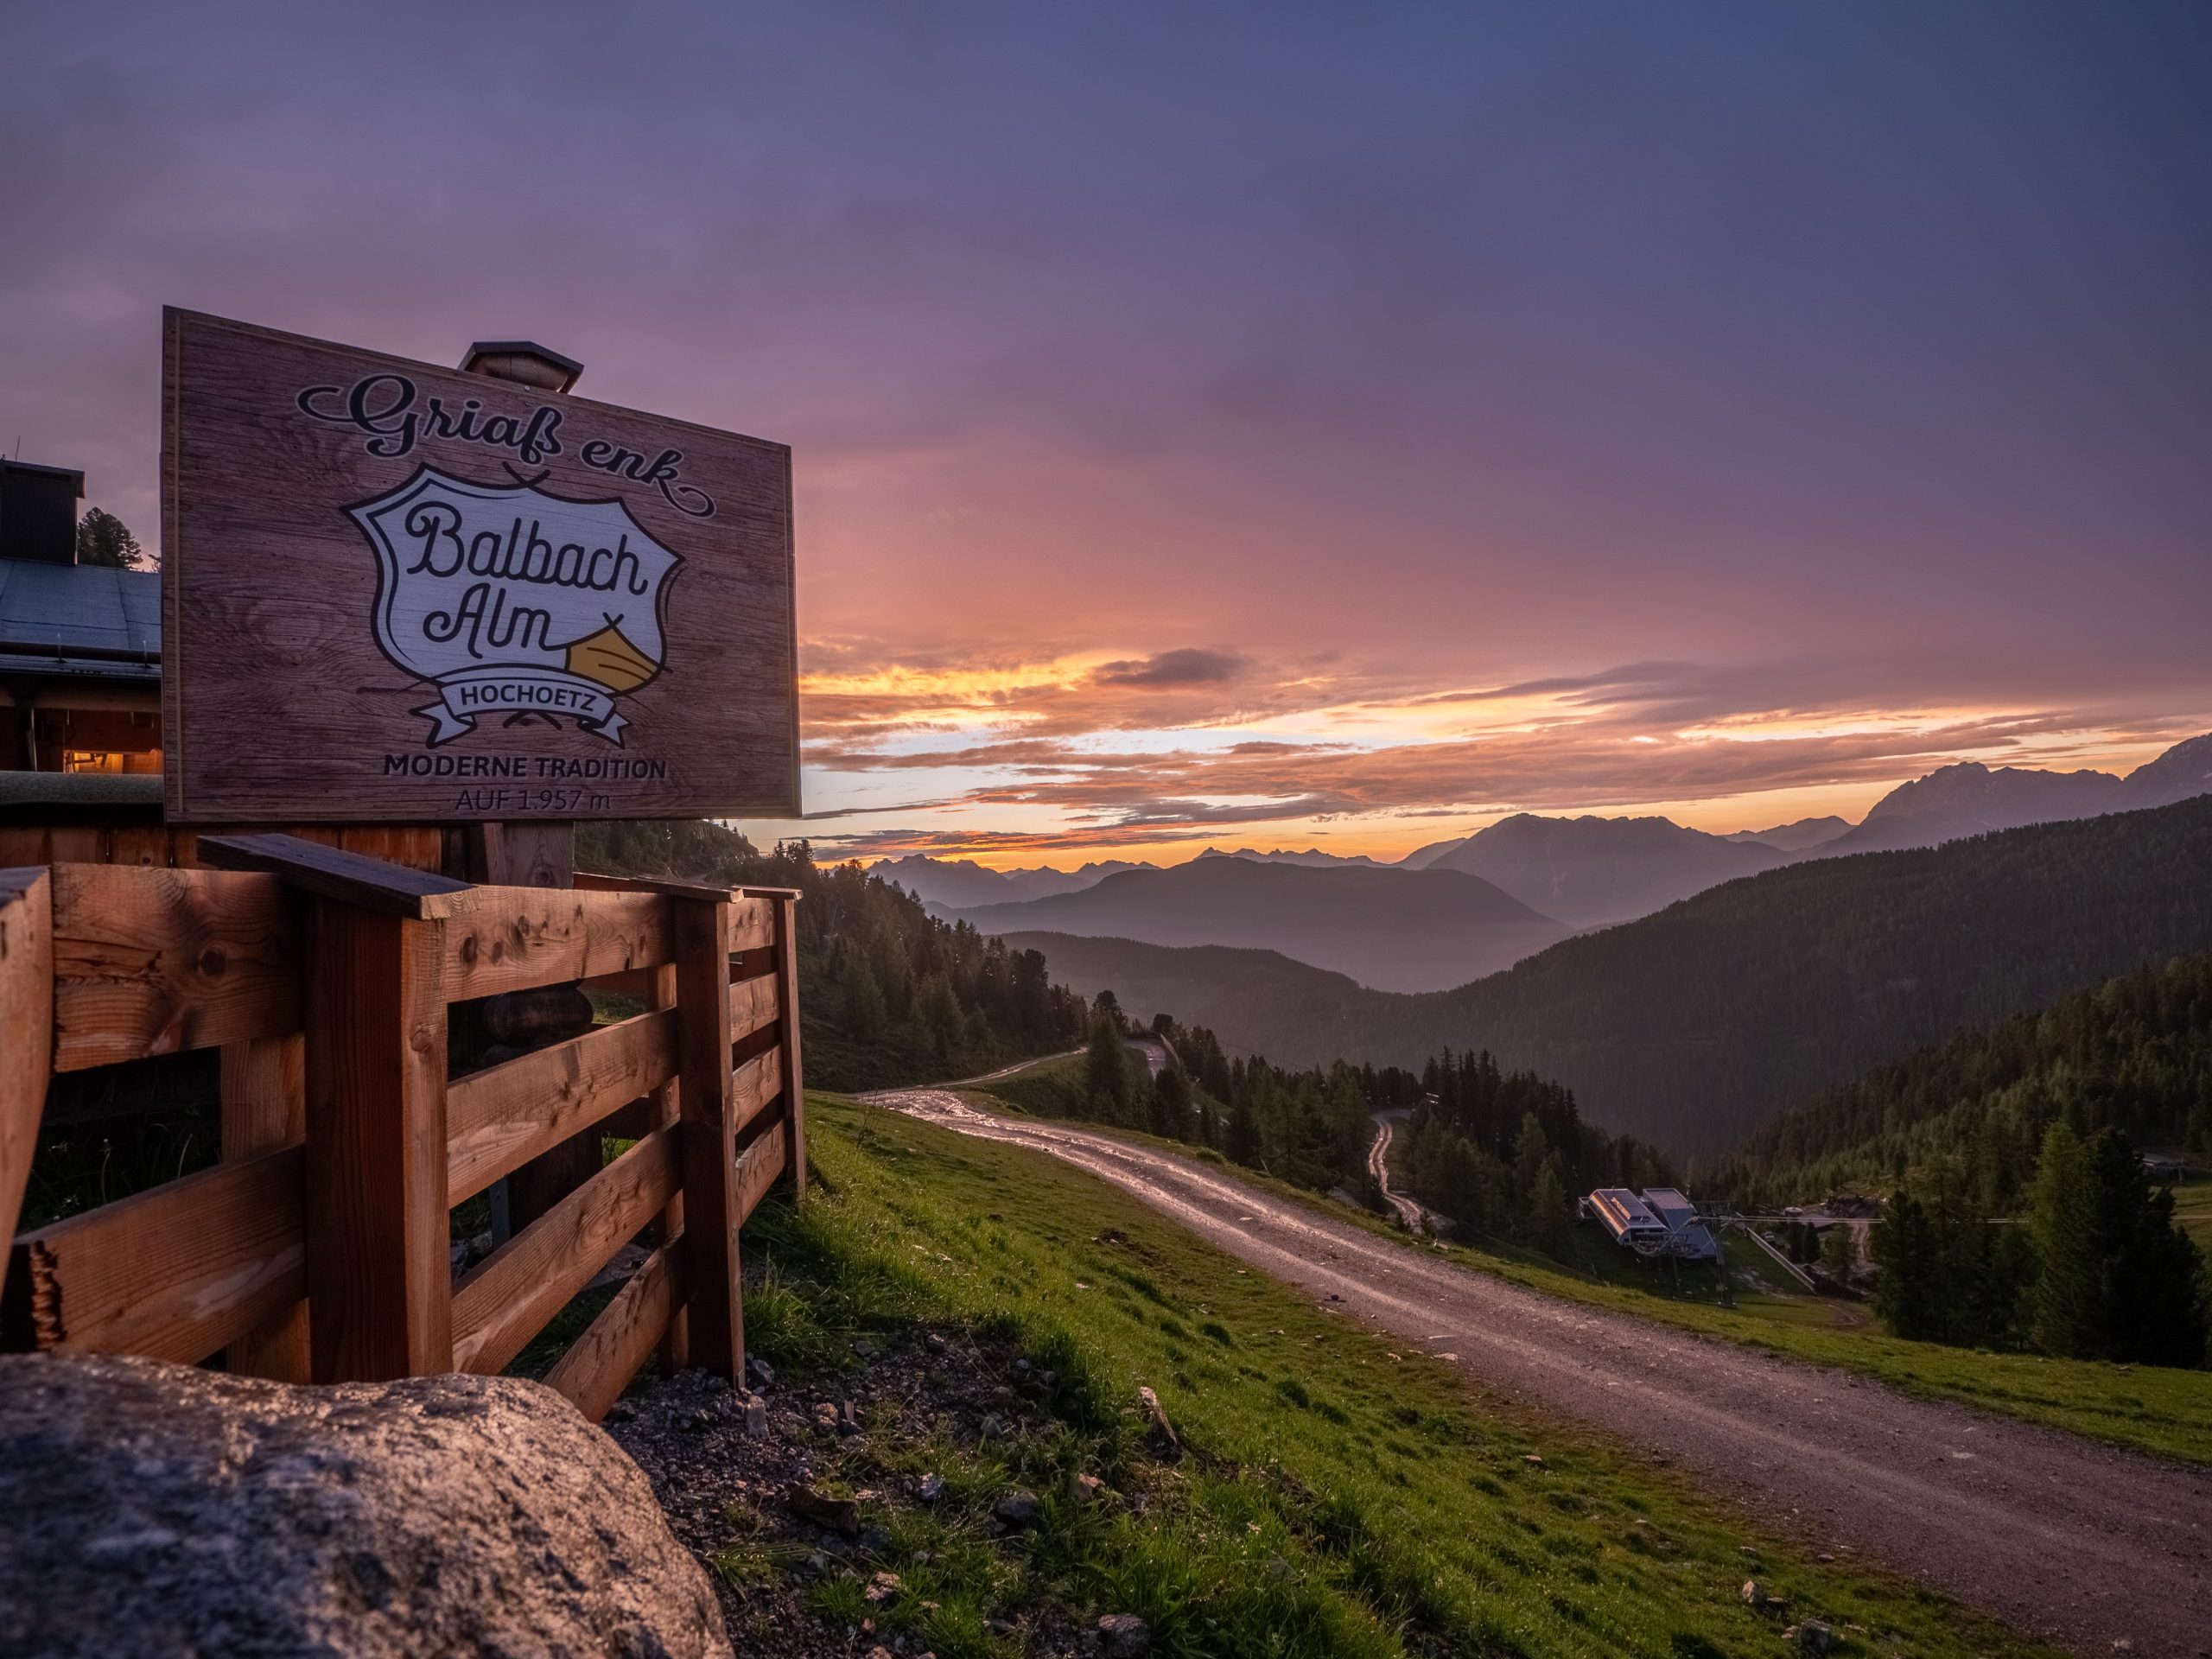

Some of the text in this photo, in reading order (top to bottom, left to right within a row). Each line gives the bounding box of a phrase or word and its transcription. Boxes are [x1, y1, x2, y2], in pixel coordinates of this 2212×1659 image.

[296, 374, 716, 518] Griaß enk
[405, 500, 648, 595] Balbach
[423, 582, 563, 659] Alm
[460, 683, 597, 712] HOCHOETZ
[384, 754, 666, 779] MODERNE TRADITION
[455, 789, 612, 810] AUF 1.957 m
